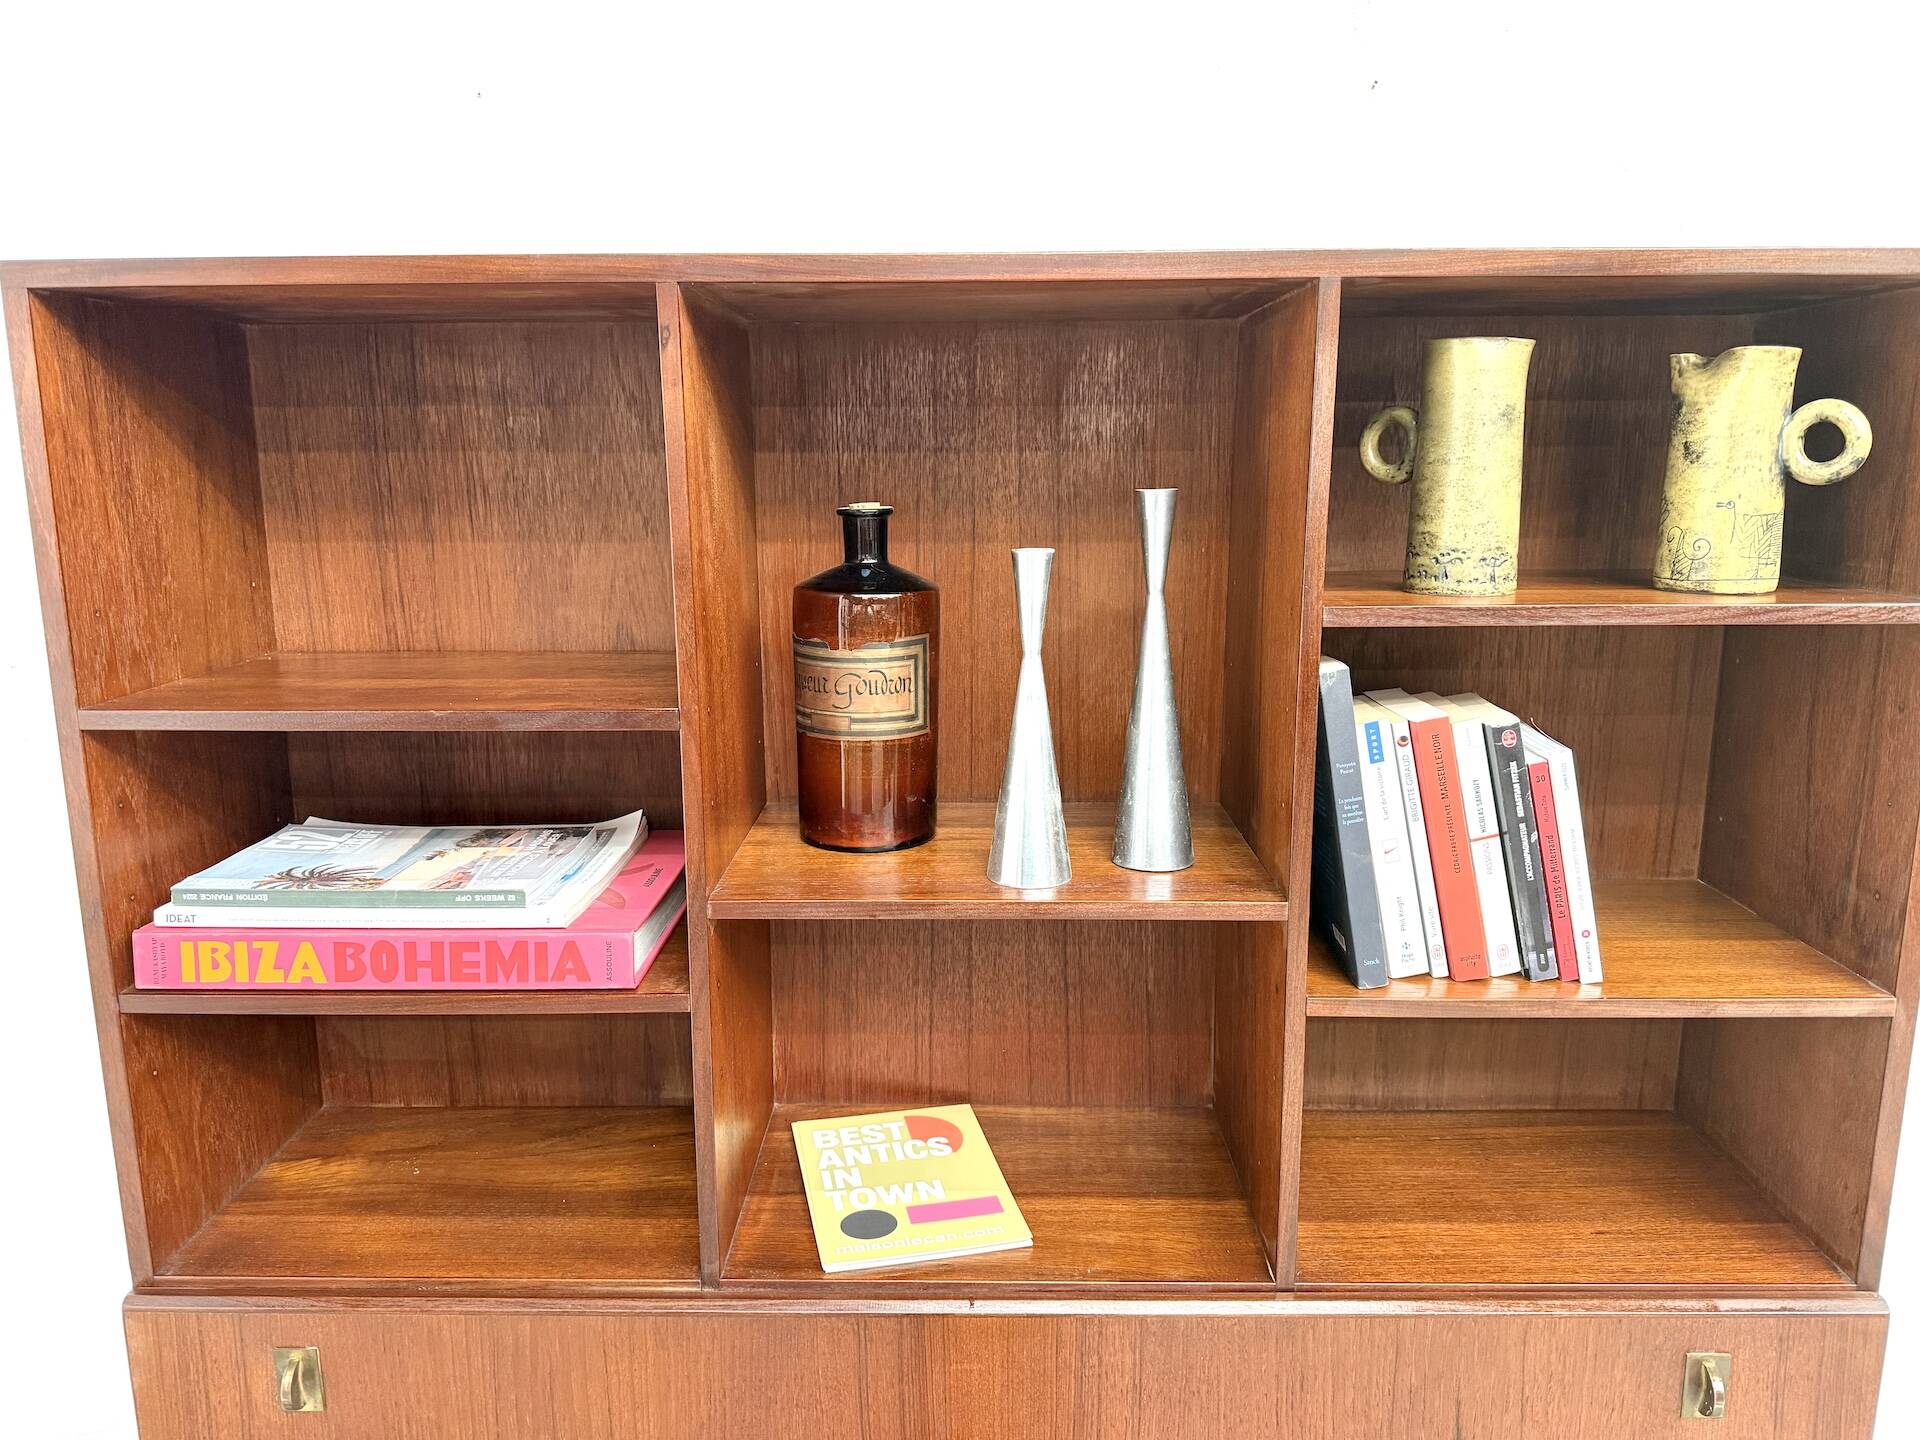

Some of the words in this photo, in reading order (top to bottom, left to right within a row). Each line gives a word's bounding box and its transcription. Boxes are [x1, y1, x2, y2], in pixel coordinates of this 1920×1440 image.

[832, 670, 914, 709] Goudron
[1370, 728, 1380, 760] SPORT
[1432, 732, 1442, 754] NOIR
[1402, 754, 1414, 786] GIRAUD
[1436, 754, 1450, 800] MARSEILLE
[1536, 774, 1546, 784] 30
[1408, 788, 1420, 822] BRIGITTE
[1472, 778, 1484, 806] SARKOZY
[1512, 783, 1525, 818] SEBASTIAN
[1476, 807, 1488, 834] NICOLAS
[1546, 835, 1560, 873] Mitterrand
[1552, 874, 1560, 885] de
[236, 894, 268, 902] ÉDITION
[454, 894, 472, 902] OFF
[474, 894, 505, 902] WEEKS
[1554, 886, 1565, 909] PARIS
[165, 913, 197, 924] IDEAT
[1558, 910, 1566, 919] Le
[180, 940, 328, 984] IBIZA
[333, 939, 592, 985] BOHEMIA
[811, 1120, 905, 1149] BEST
[817, 1136, 953, 1170] ANTICS
[820, 1167, 864, 1190] IN
[823, 1178, 947, 1212] TOWN
